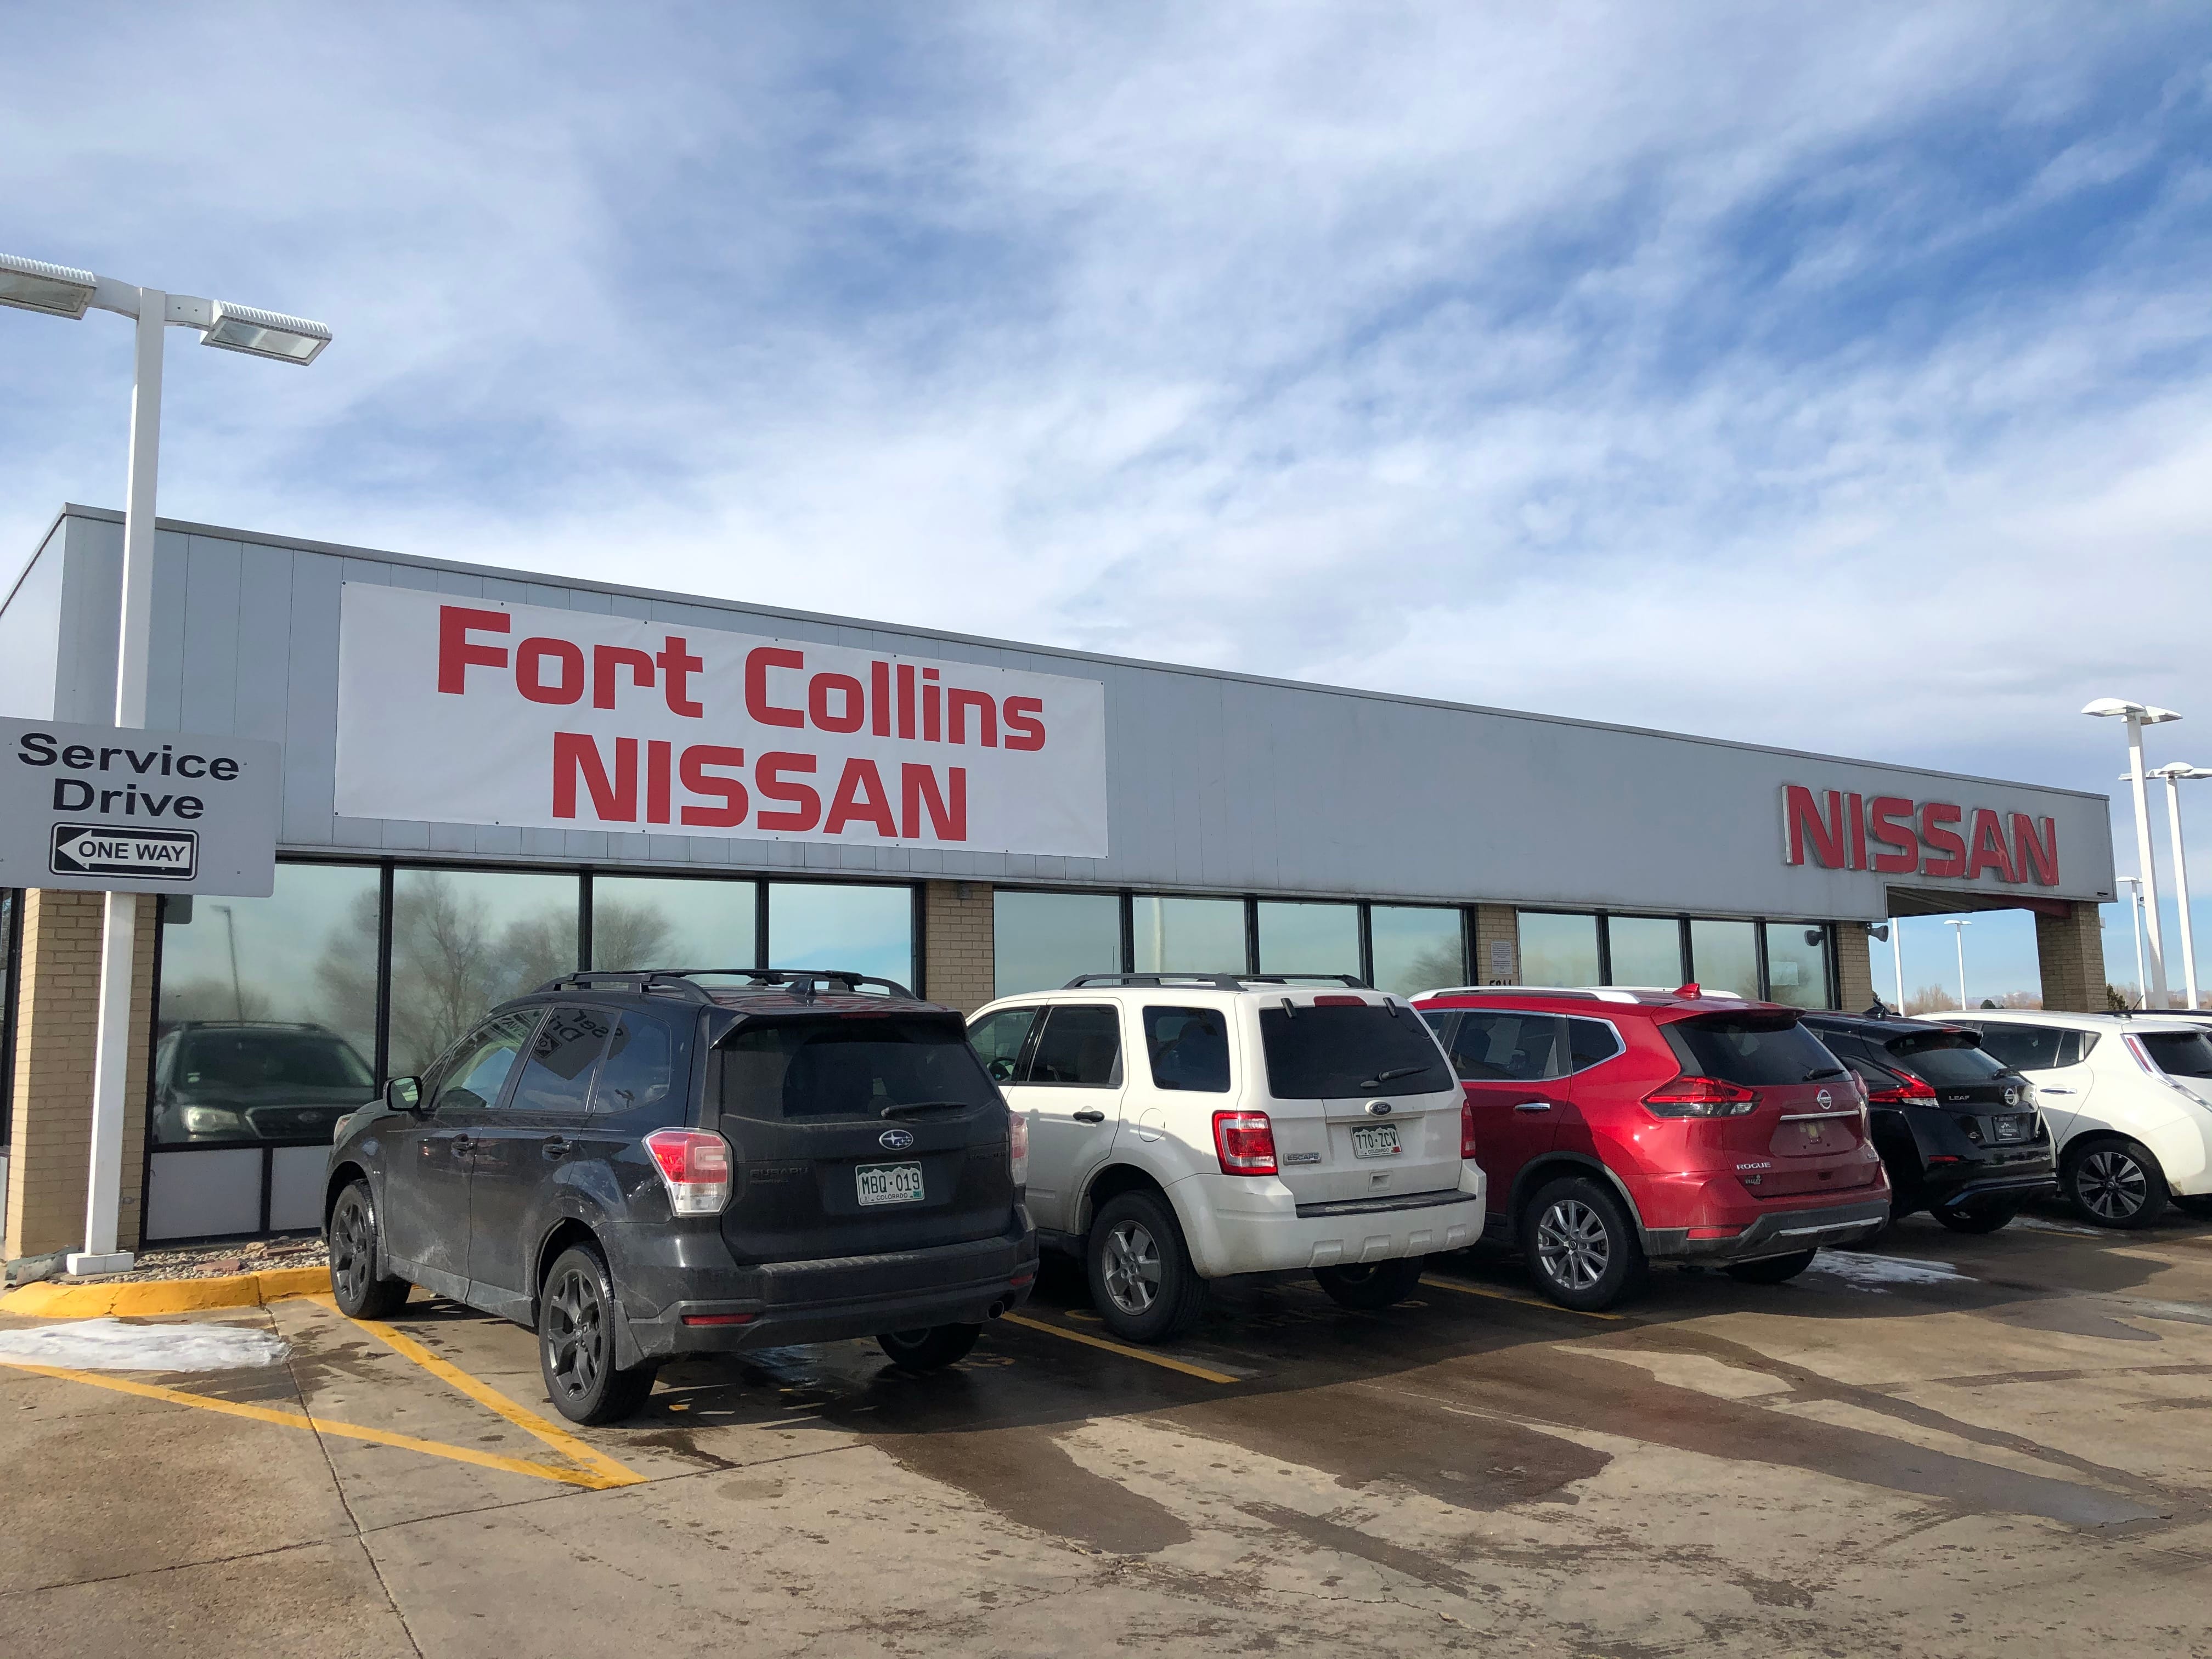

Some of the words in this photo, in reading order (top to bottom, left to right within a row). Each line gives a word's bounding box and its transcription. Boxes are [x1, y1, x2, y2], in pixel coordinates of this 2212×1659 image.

[438, 605, 703, 718] Fort
[745, 647, 1046, 751] Collins
[18, 732, 239, 781] Service
[53, 778, 204, 819] Drive
[552, 732, 967, 841] NISSAN
[78, 840, 129, 859] ONE
[136, 843, 187, 862] WAY
[1781, 785, 2059, 885] NISSAN
[1736, 1162, 1771, 1170] ROGUE
